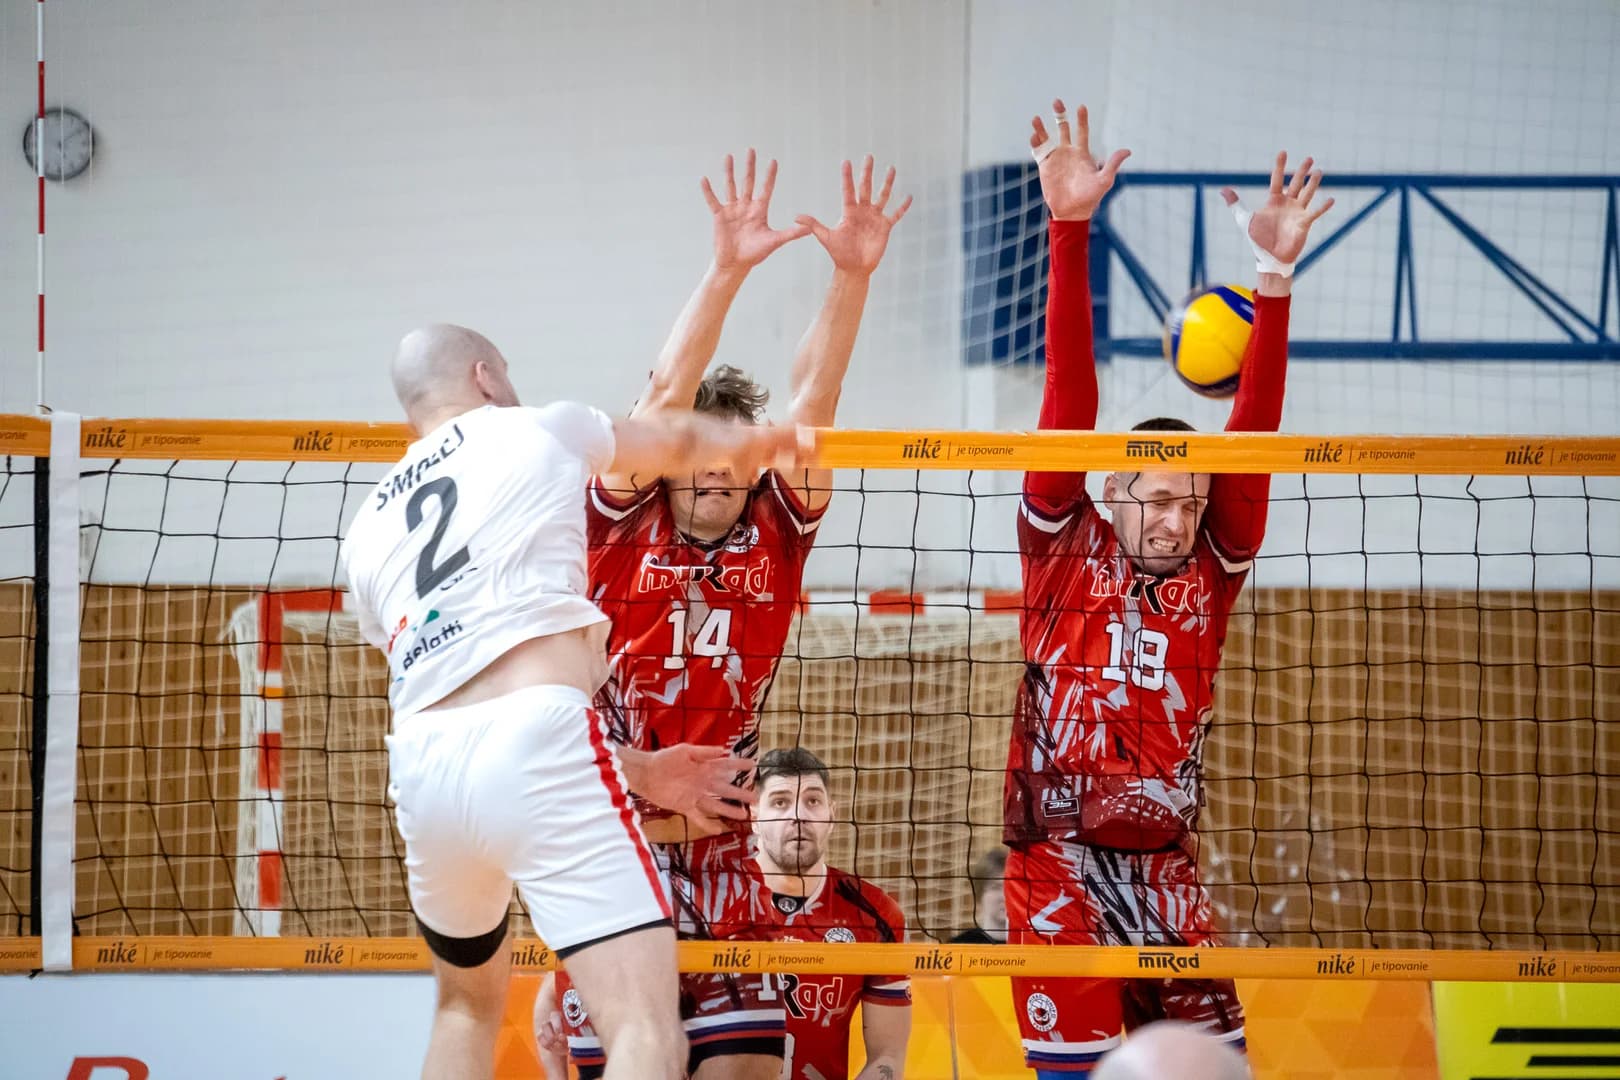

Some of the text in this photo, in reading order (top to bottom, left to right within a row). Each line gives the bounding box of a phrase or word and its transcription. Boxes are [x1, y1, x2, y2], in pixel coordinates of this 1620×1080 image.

[86, 429, 126, 449] niké
[141, 434, 151, 449] je
[293, 430, 333, 452] niké
[348, 437, 358, 450] je
[902, 437, 941, 459] niké
[956, 445, 966, 457] je
[1304, 441, 1343, 463] niké
[1358, 449, 1368, 461] je
[1505, 444, 1543, 465] niké
[1560, 452, 1570, 464] je
[405, 476, 470, 600] 2
[663, 608, 732, 669] 14
[1101, 620, 1169, 692] 18
[97, 941, 137, 964] niké
[153, 949, 163, 962] je
[304, 942, 344, 965] niké
[360, 950, 370, 963] je
[712, 946, 752, 968] niké
[767, 953, 777, 965] je
[914, 949, 953, 971] niké
[969, 957, 979, 969] je
[1317, 953, 1355, 975] niké
[1371, 961, 1381, 973] je
[1518, 956, 1620, 977] niké je tipovan
[784, 972, 843, 1019] Rad
